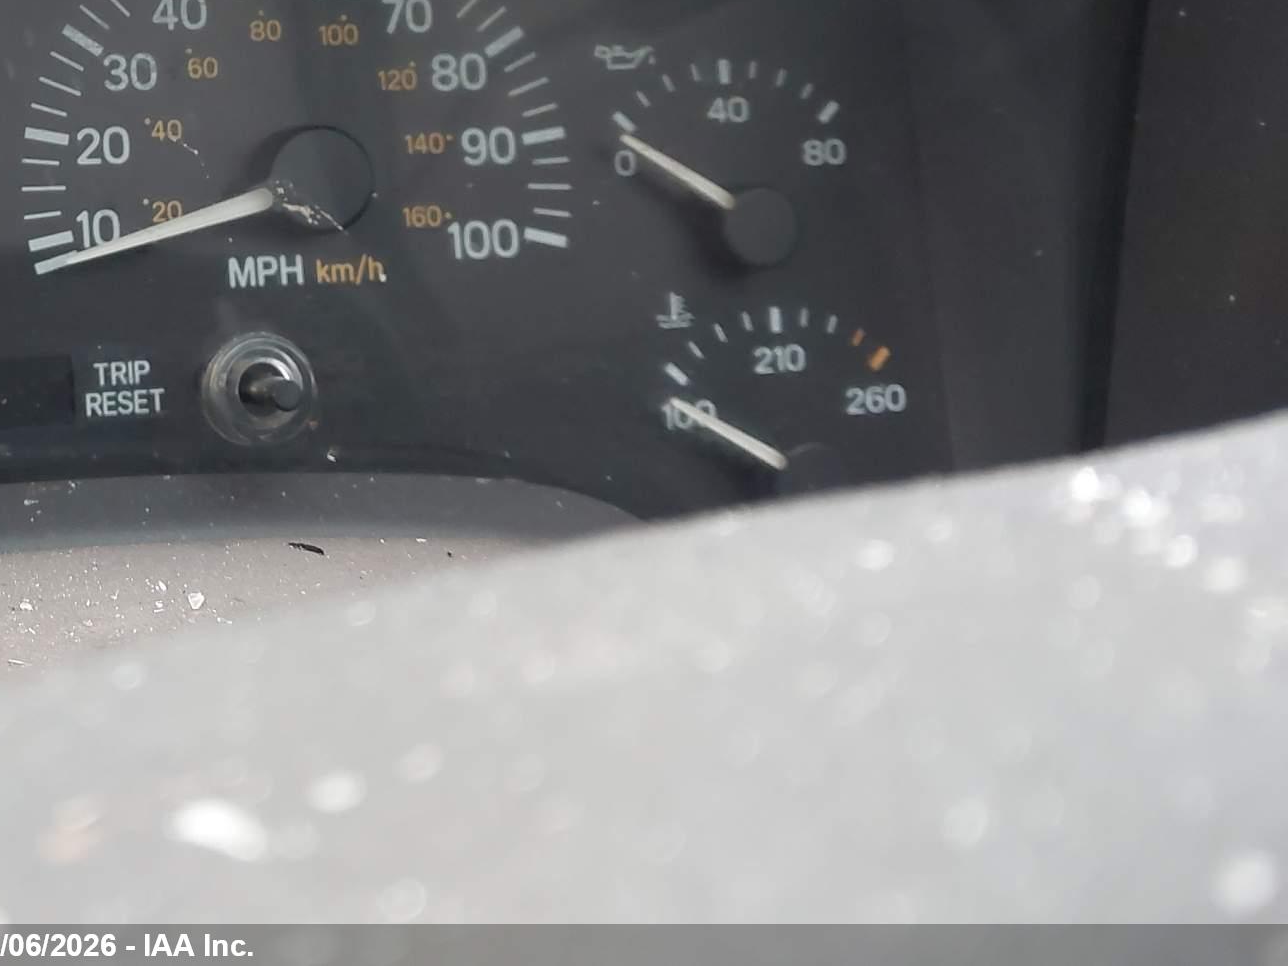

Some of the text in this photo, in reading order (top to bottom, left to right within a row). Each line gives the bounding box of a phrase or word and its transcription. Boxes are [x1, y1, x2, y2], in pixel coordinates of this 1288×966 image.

[249, 19, 282, 42] 80
[318, 23, 359, 46] 100
[103, 52, 158, 91] 30
[187, 56, 218, 79] 60
[377, 67, 418, 91] 120
[431, 52, 487, 92] 80
[707, 96, 749, 123] 40
[151, 119, 182, 143] 40
[404, 132, 445, 155] 140
[76, 126, 130, 165] 20
[461, 126, 516, 166] 90
[802, 138, 846, 166] 80
[614, 150, 637, 177] 0
[152, 200, 183, 224] 20
[402, 205, 443, 228] 160
[75, 208, 120, 249] 10
[447, 219, 519, 260] 100
[228, 254, 385, 289] MPH km/h
[753, 343, 806, 375] 210
[93, 360, 151, 387] TRIP
[85, 387, 165, 417] RESET
[845, 384, 906, 415] 260
